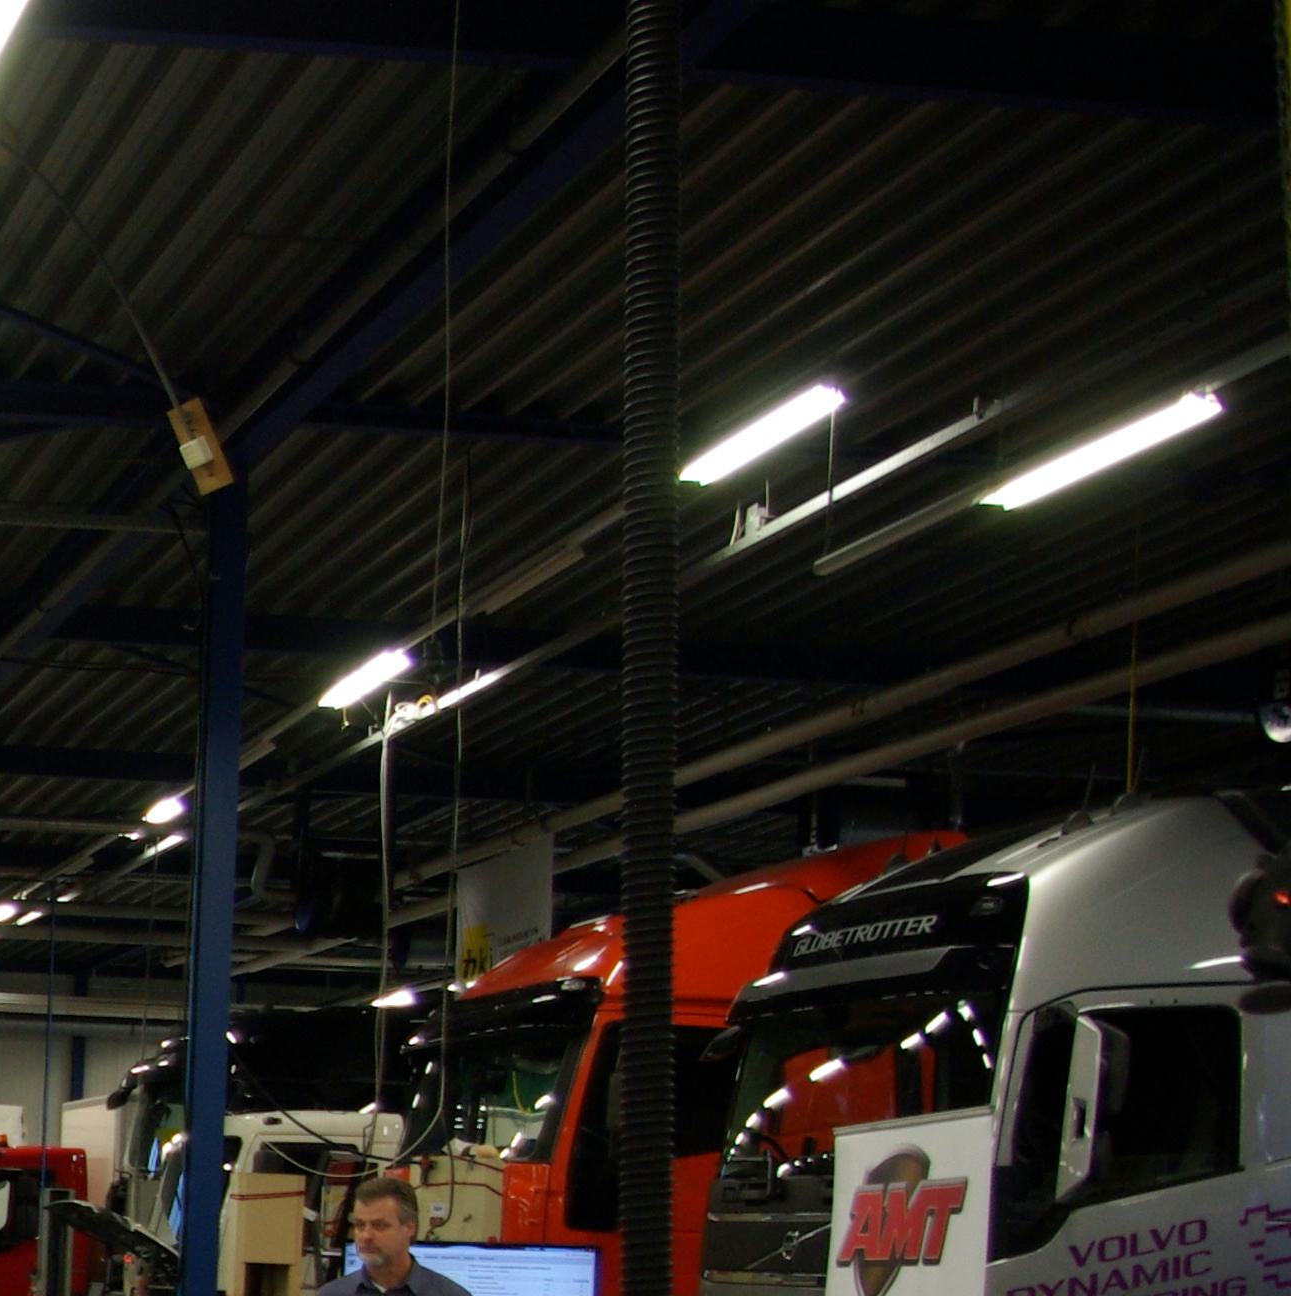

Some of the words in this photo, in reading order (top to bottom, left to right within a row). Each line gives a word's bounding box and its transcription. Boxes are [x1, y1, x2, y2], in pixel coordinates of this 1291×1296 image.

[793, 914, 938, 957] GLOBETROTTER
[836, 1176, 968, 1267] AMT
[1070, 1219, 1207, 1267] VOLVO
